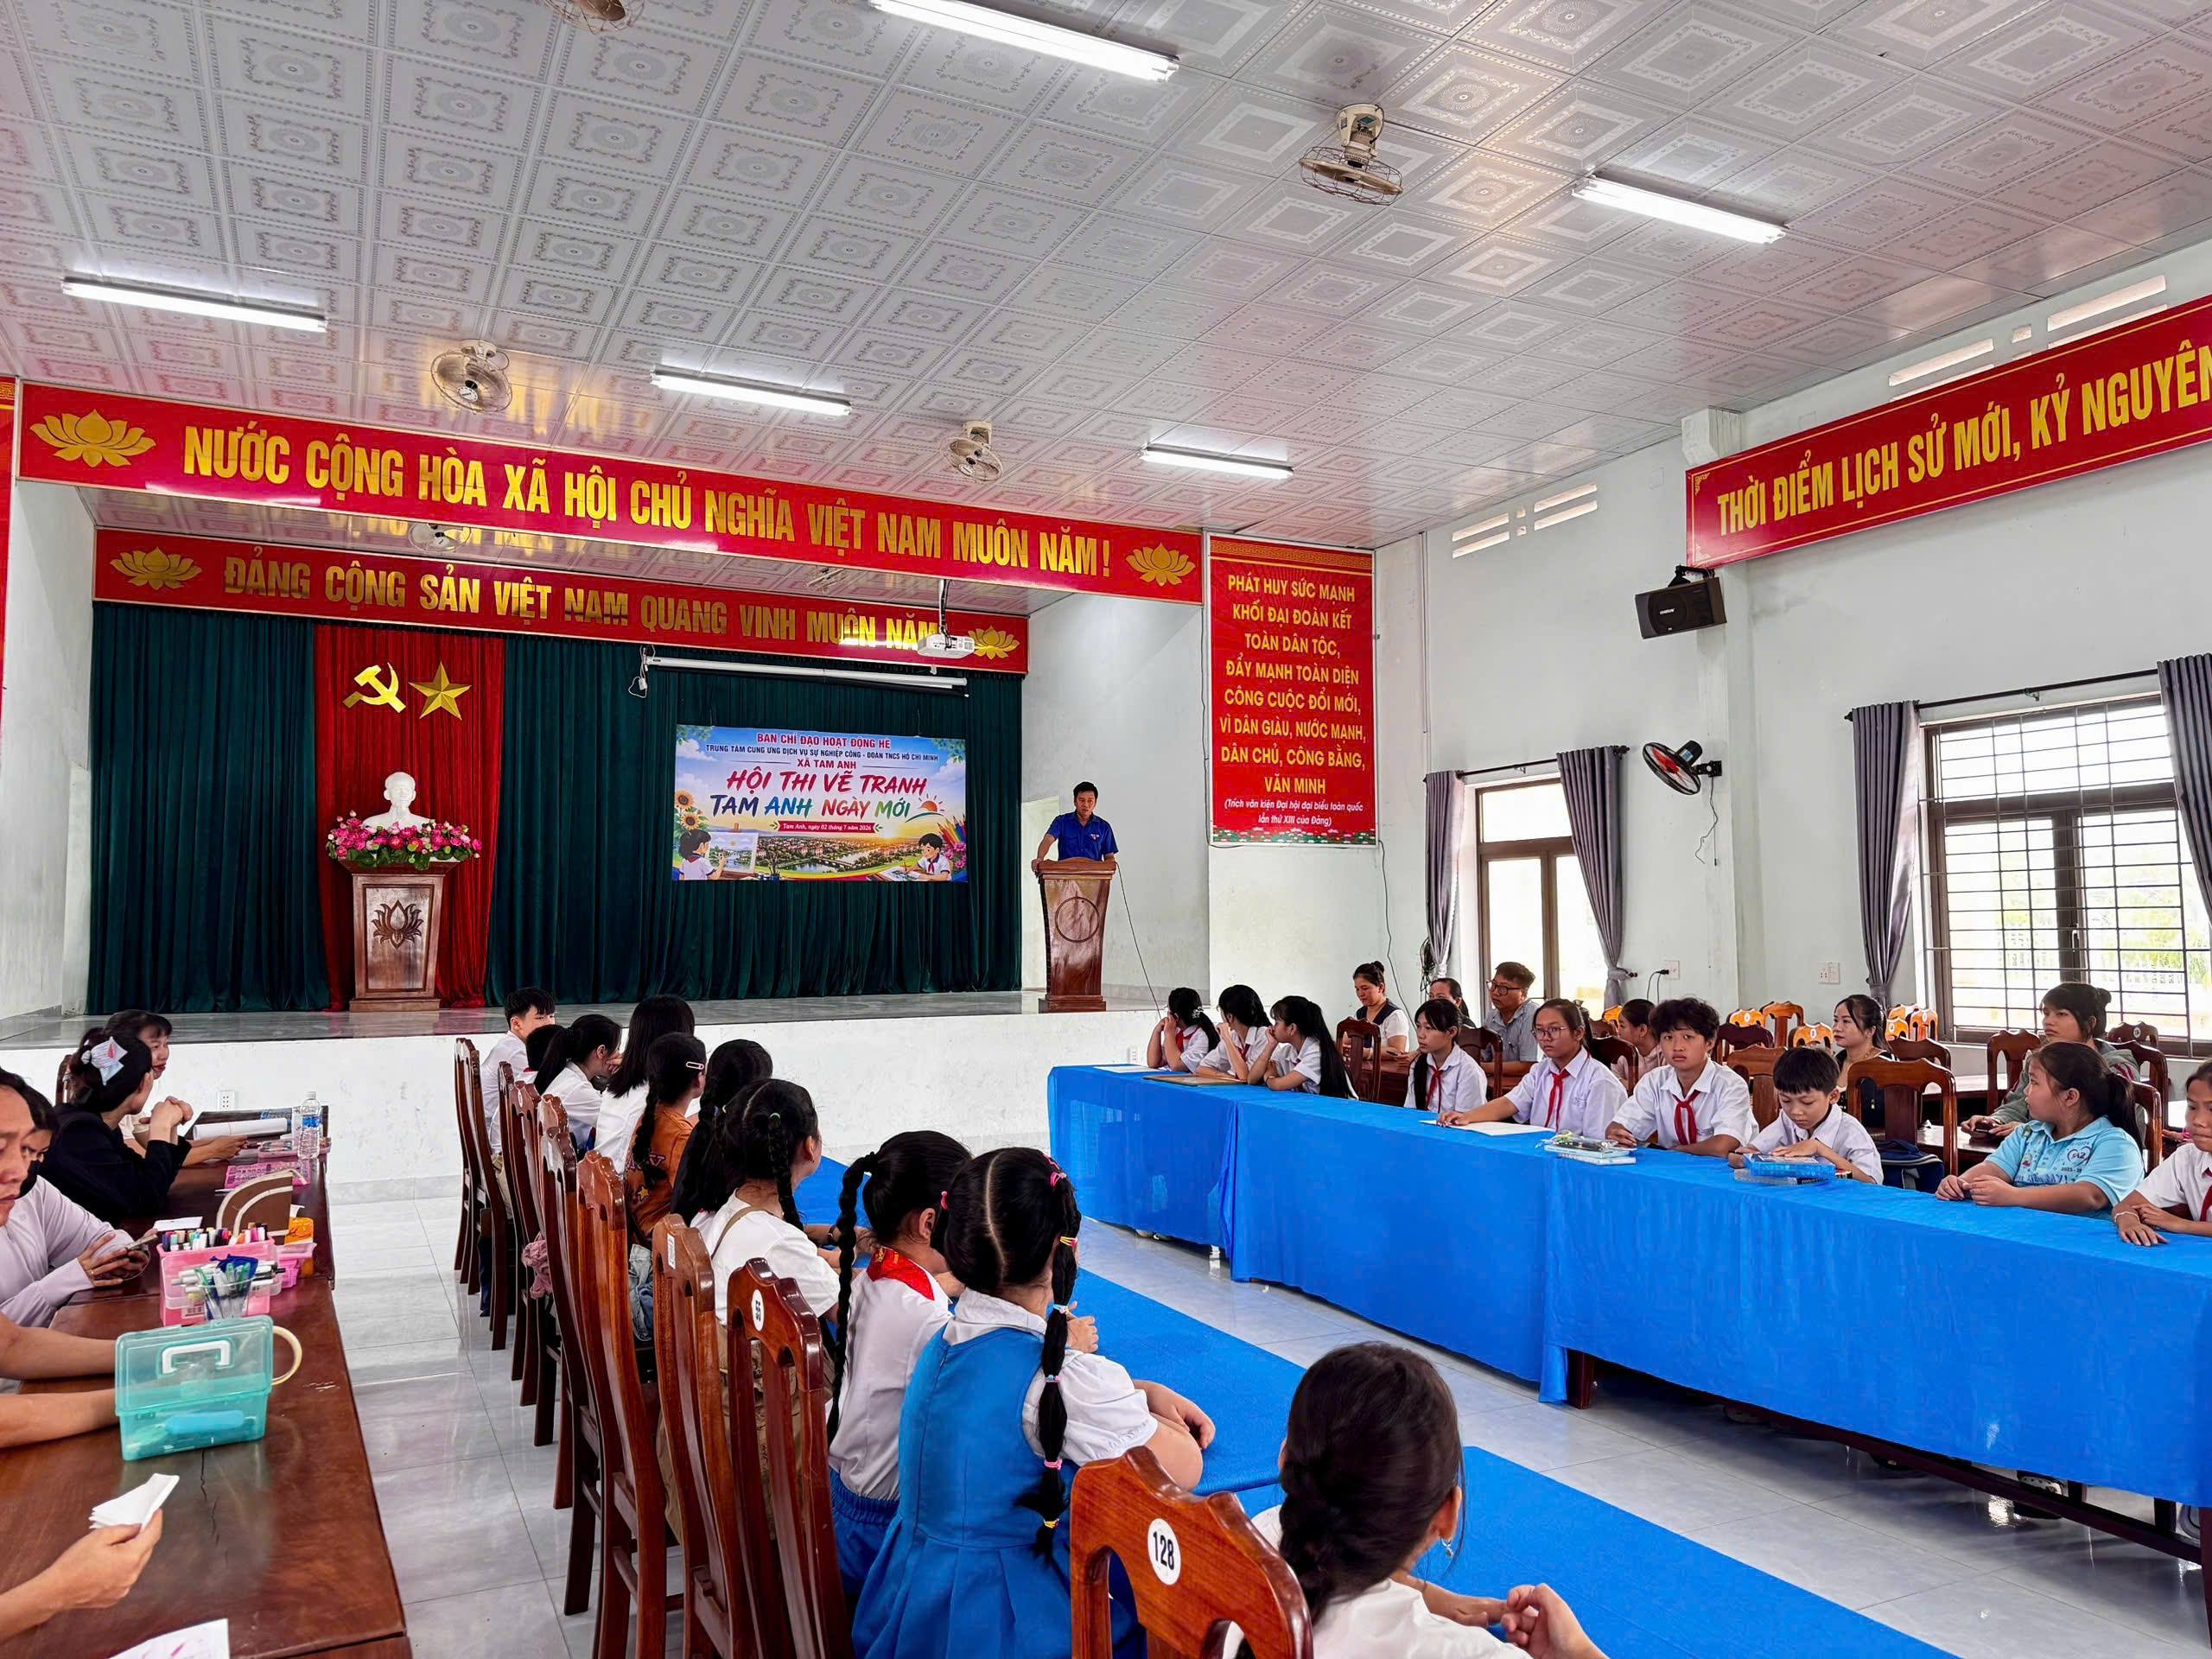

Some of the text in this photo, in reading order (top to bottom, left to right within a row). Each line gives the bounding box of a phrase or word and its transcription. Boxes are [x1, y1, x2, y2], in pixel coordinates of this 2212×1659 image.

[1717, 339, 2212, 537] THỜI ĐIỂM LỊCH SỬ MỚI, KỶ NGUYÊN
[183, 421, 290, 484] NƯỚC
[305, 435, 404, 502] CỘNG
[418, 446, 486, 507] HÒA
[502, 456, 550, 512] XÃ
[563, 465, 616, 529] HỘI
[630, 471, 691, 530] CHỦ
[704, 487, 795, 542] NGHĨA
[807, 499, 866, 556] VIỆT
[877, 511, 941, 559] NAM
[953, 518, 1029, 569] MUÔN
[224, 545, 311, 600] ĐẢNG
[325, 560, 406, 611] CỘNG
[419, 563, 480, 614] SẢN
[493, 575, 552, 626] VIỆT
[564, 588, 628, 627] NAM
[640, 594, 728, 636] QUANG
[739, 605, 796, 639] VINH
[806, 607, 876, 648] MUÔN
[1228, 572, 1355, 605] PHÁT HUY SỨC MẠNH
[1233, 600, 1352, 629] KHỐI ĐẠI ĐOÀN KẾT
[1245, 630, 1340, 658] TOÀN DÂN TỘC,
[1226, 652, 1359, 689] ĐẨY MẠNH TOÀN DIỆN
[1224, 685, 1361, 715] CÔNG CUỘC ĐỔI MỚI,
[757, 734, 777, 743] BAN
[781, 732, 797, 744] CHỈ
[800, 734, 819, 747] ĐẠO
[823, 736, 847, 747] HOẠT
[1220, 714, 1366, 743] VÌ DÂN GIÀU, NƯỚC MẠNH,
[798, 758, 856, 770] XÃ TAM ANH
[1222, 742, 1365, 771] DÂN CHỦ, CÔNG BẰNG,
[727, 766, 927, 796] HỘI THI VẼ TRANH
[1265, 773, 1325, 793] VĂN MINH
[710, 794, 910, 820] TAM ANH NGÀY MỚI
[1276, 801, 1287, 810] Đại
[1289, 800, 1300, 811] hội
[1301, 802, 1313, 811] đại
[1314, 799, 1328, 810] biểu
[1330, 802, 1344, 810] toàn
[1347, 802, 1363, 811] quốc
[1284, 815, 1295, 823] XIII
[1153, 1531, 1174, 1570] 128
